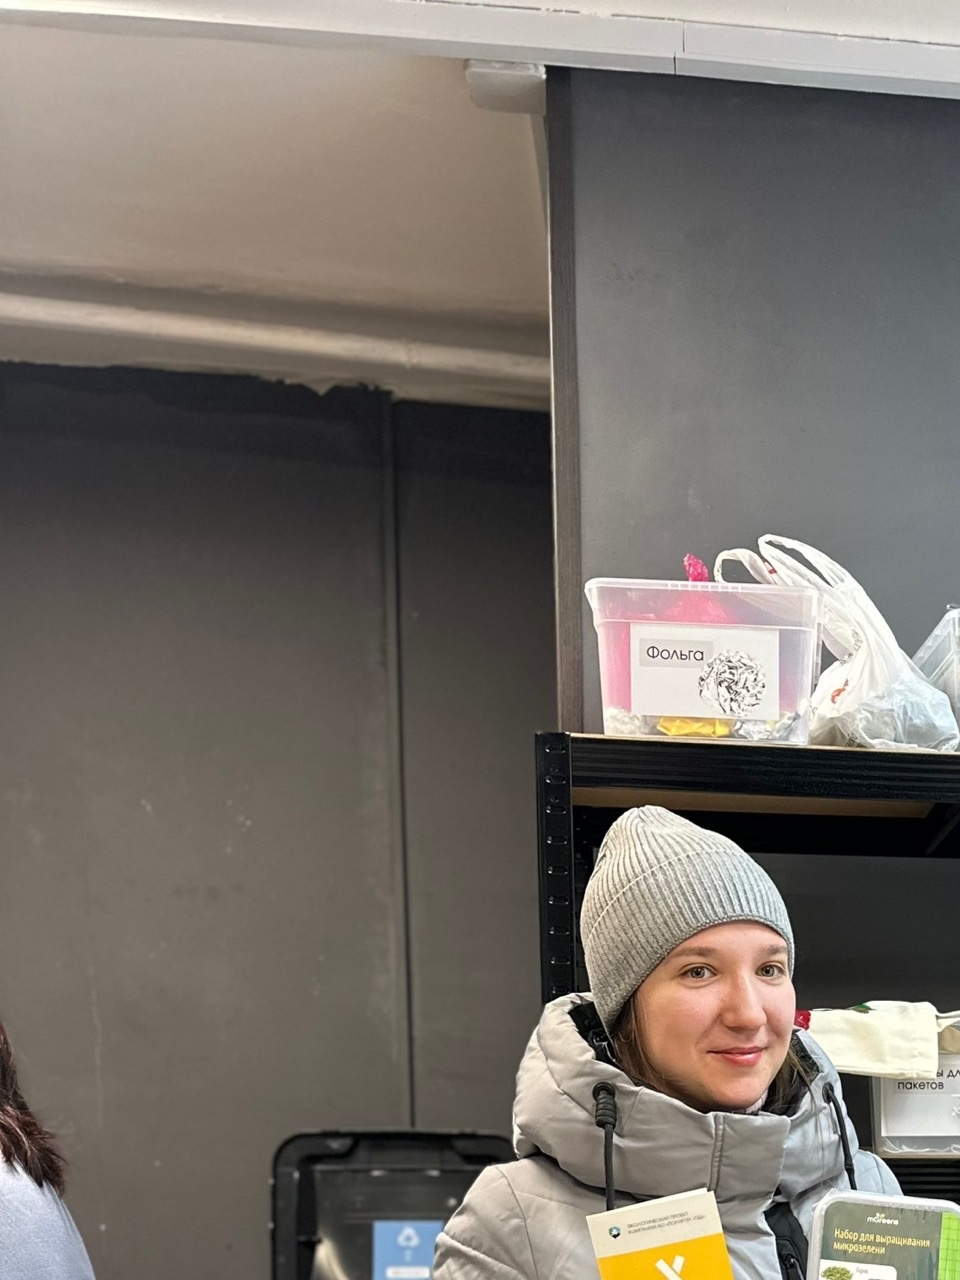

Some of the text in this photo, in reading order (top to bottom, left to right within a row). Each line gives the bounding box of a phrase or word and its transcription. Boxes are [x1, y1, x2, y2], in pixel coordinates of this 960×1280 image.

[646, 645, 704, 662] Фольга
[897, 1081, 944, 1090] пакетов
[834, 1228, 931, 1248] Набор для выращивания
[833, 1241, 886, 1255] микрозелени
